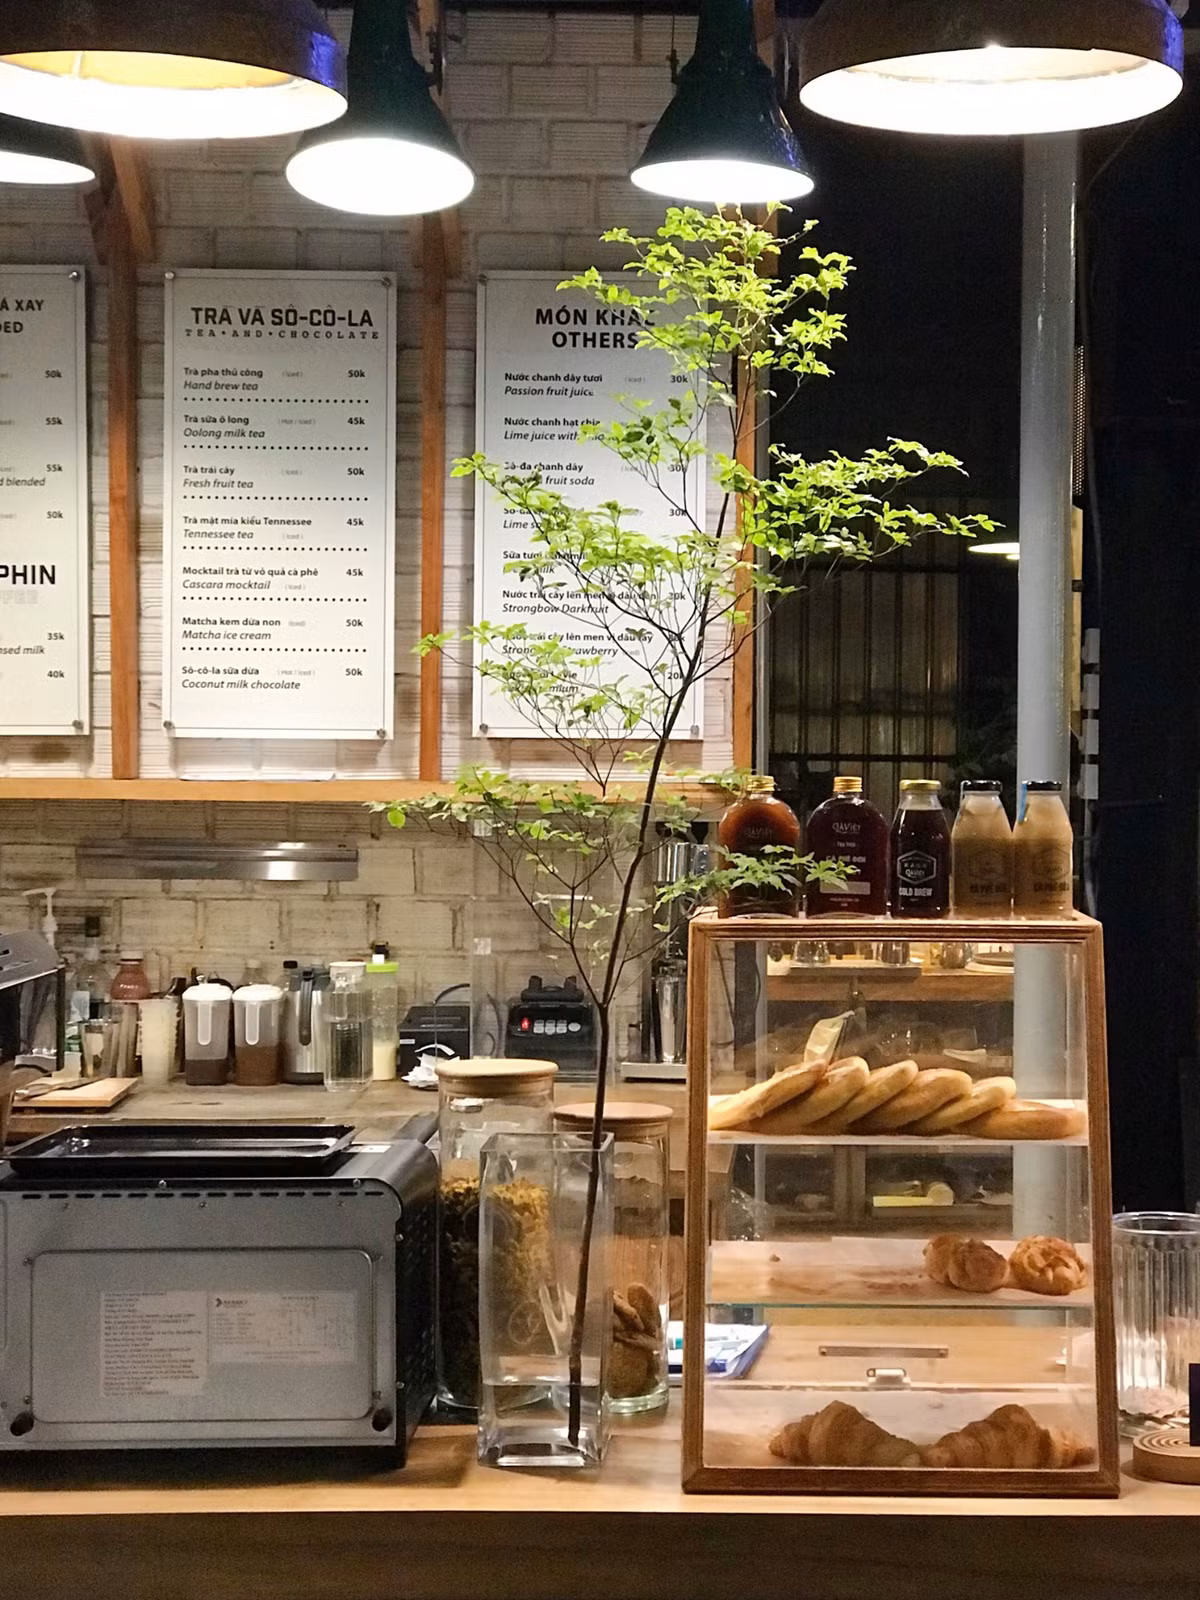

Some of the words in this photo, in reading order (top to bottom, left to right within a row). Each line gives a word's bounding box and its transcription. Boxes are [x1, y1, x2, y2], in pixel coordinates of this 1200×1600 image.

[15, 299, 45, 312] XAY
[535, 305, 587, 326] MÓN
[185, 329, 216, 337] TEA
[232, 329, 263, 338] AND
[278, 330, 380, 340] CHOCOLATE
[551, 331, 639, 349] OTHERS
[45, 369, 63, 379] 50k
[201, 368, 219, 379] pha
[347, 369, 365, 378] 50k
[531, 372, 561, 382] chanh
[670, 374, 689, 384] 30k
[183, 380, 212, 390] Hand
[214, 380, 240, 390] brew
[242, 382, 259, 391] tea
[504, 385, 545, 396] Passion
[546, 385, 568, 397] fruit
[45, 416, 63, 426] 55k
[227, 415, 250, 426] long
[347, 416, 365, 425] 45k
[531, 417, 561, 427] chanh
[183, 427, 222, 440] Oolong
[224, 428, 246, 438] milk
[248, 430, 266, 438] tea
[504, 430, 530, 441] Lime
[531, 431, 556, 443] juice
[46, 463, 63, 473] 55k
[347, 467, 365, 476] 50k
[6, 477, 46, 487] blended
[183, 478, 211, 488] Fresh
[212, 478, 235, 489] fruit
[237, 480, 254, 489] tea
[545, 475, 569, 486] fruit
[569, 475, 595, 486] soda
[47, 510, 64, 520] 50k
[263, 517, 312, 526] Tennessee
[346, 517, 364, 526] 45k
[502, 519, 529, 530] Lime
[183, 528, 235, 539] Tennessee
[237, 530, 254, 539] tea
[182, 566, 224, 575] Mocktail
[345, 568, 364, 577] 45k
[182, 579, 223, 589] Cascara
[225, 580, 272, 590] mocktail
[502, 603, 560, 615] Strongbow
[182, 616, 217, 626] Matcha
[219, 617, 240, 626] kem
[262, 619, 281, 627] non
[345, 619, 363, 627] 50k
[47, 632, 65, 641] 35k
[182, 630, 221, 640] Matcha
[223, 630, 238, 640] ice
[239, 631, 272, 640] cream
[583, 633, 604, 642] men
[23, 645, 45, 655] milk
[47, 670, 65, 679] 40k
[345, 668, 363, 677] 50k
[181, 678, 224, 689] Coconut
[226, 679, 249, 689] milk
[250, 679, 301, 690] chocolate
